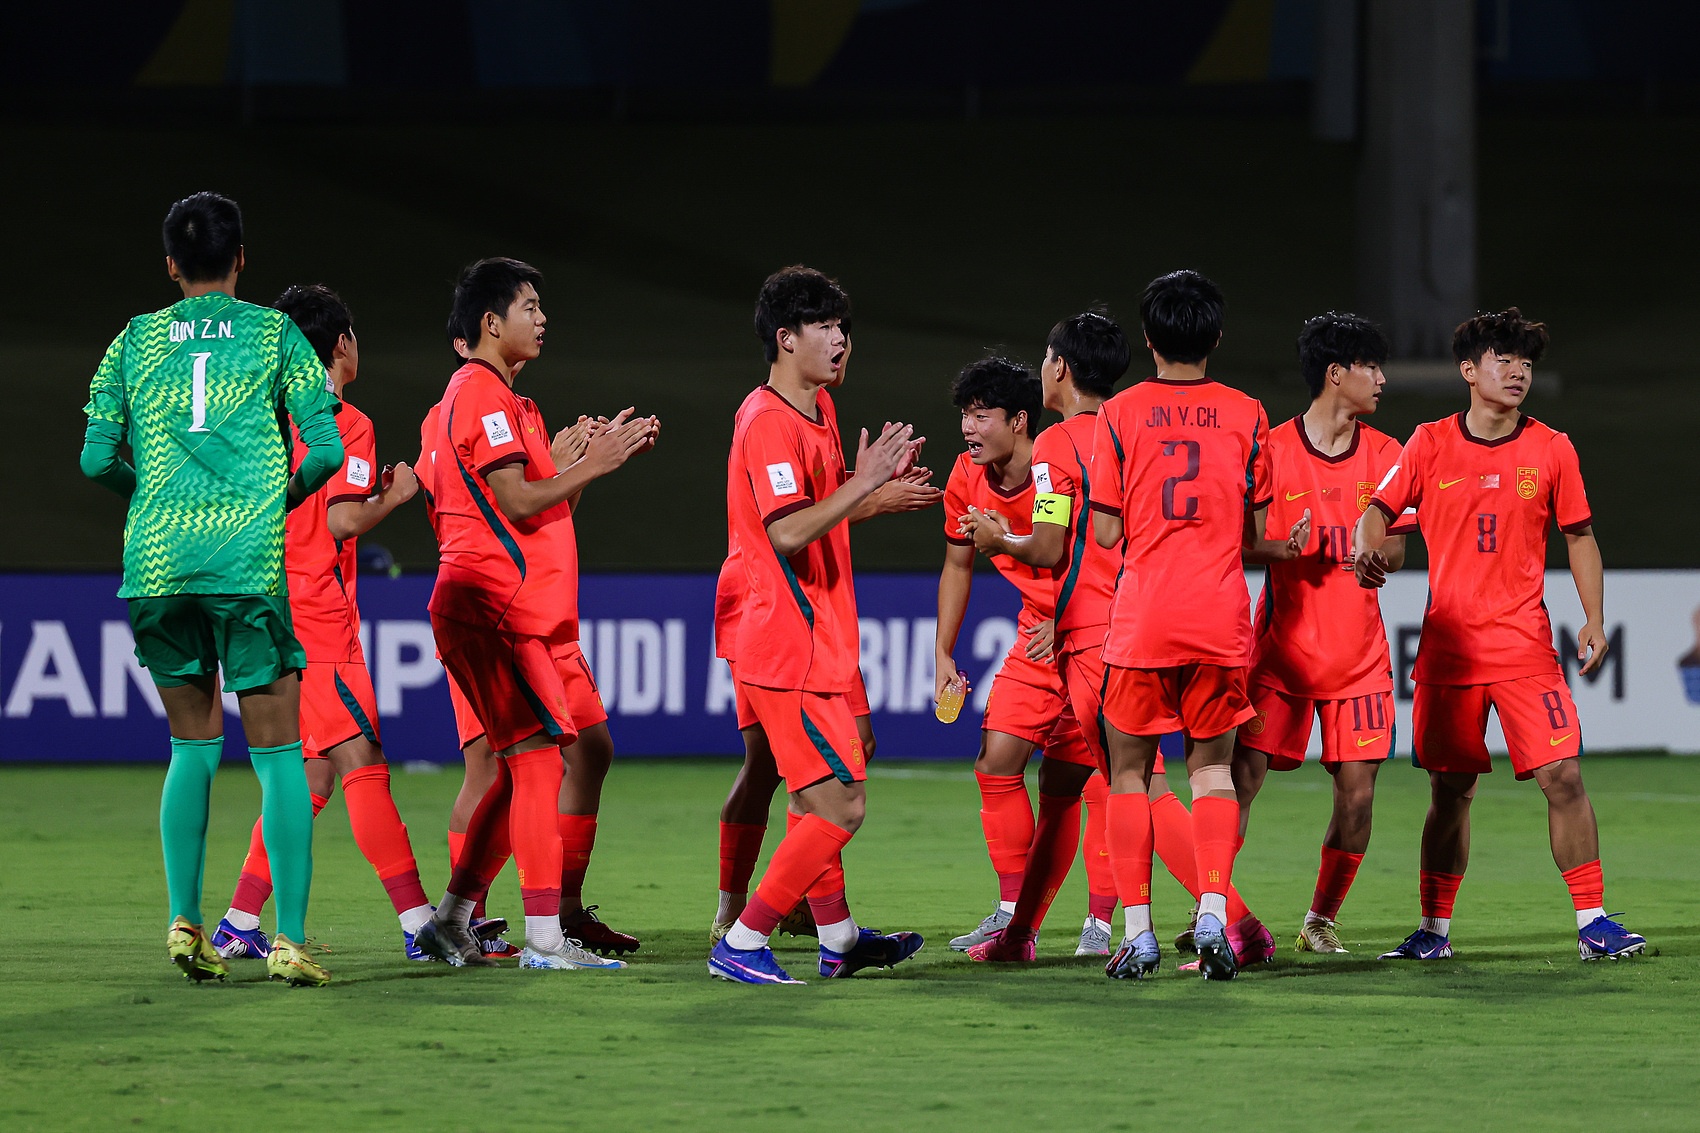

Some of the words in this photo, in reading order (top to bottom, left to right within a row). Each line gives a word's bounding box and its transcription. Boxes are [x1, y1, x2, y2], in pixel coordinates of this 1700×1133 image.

[169, 319, 196, 342] QIN
[201, 318, 235, 339] Z.N.
[187, 351, 212, 433] 1
[1146, 405, 1171, 428] JIN
[1036, 472, 1048, 484] AFC
[1157, 440, 1203, 521] 2
[1317, 525, 1351, 564] 10
[1476, 513, 1498, 553] 8
[579, 618, 686, 716] UDI
[1352, 692, 1387, 732] 10
[1538, 690, 1571, 730] 8
